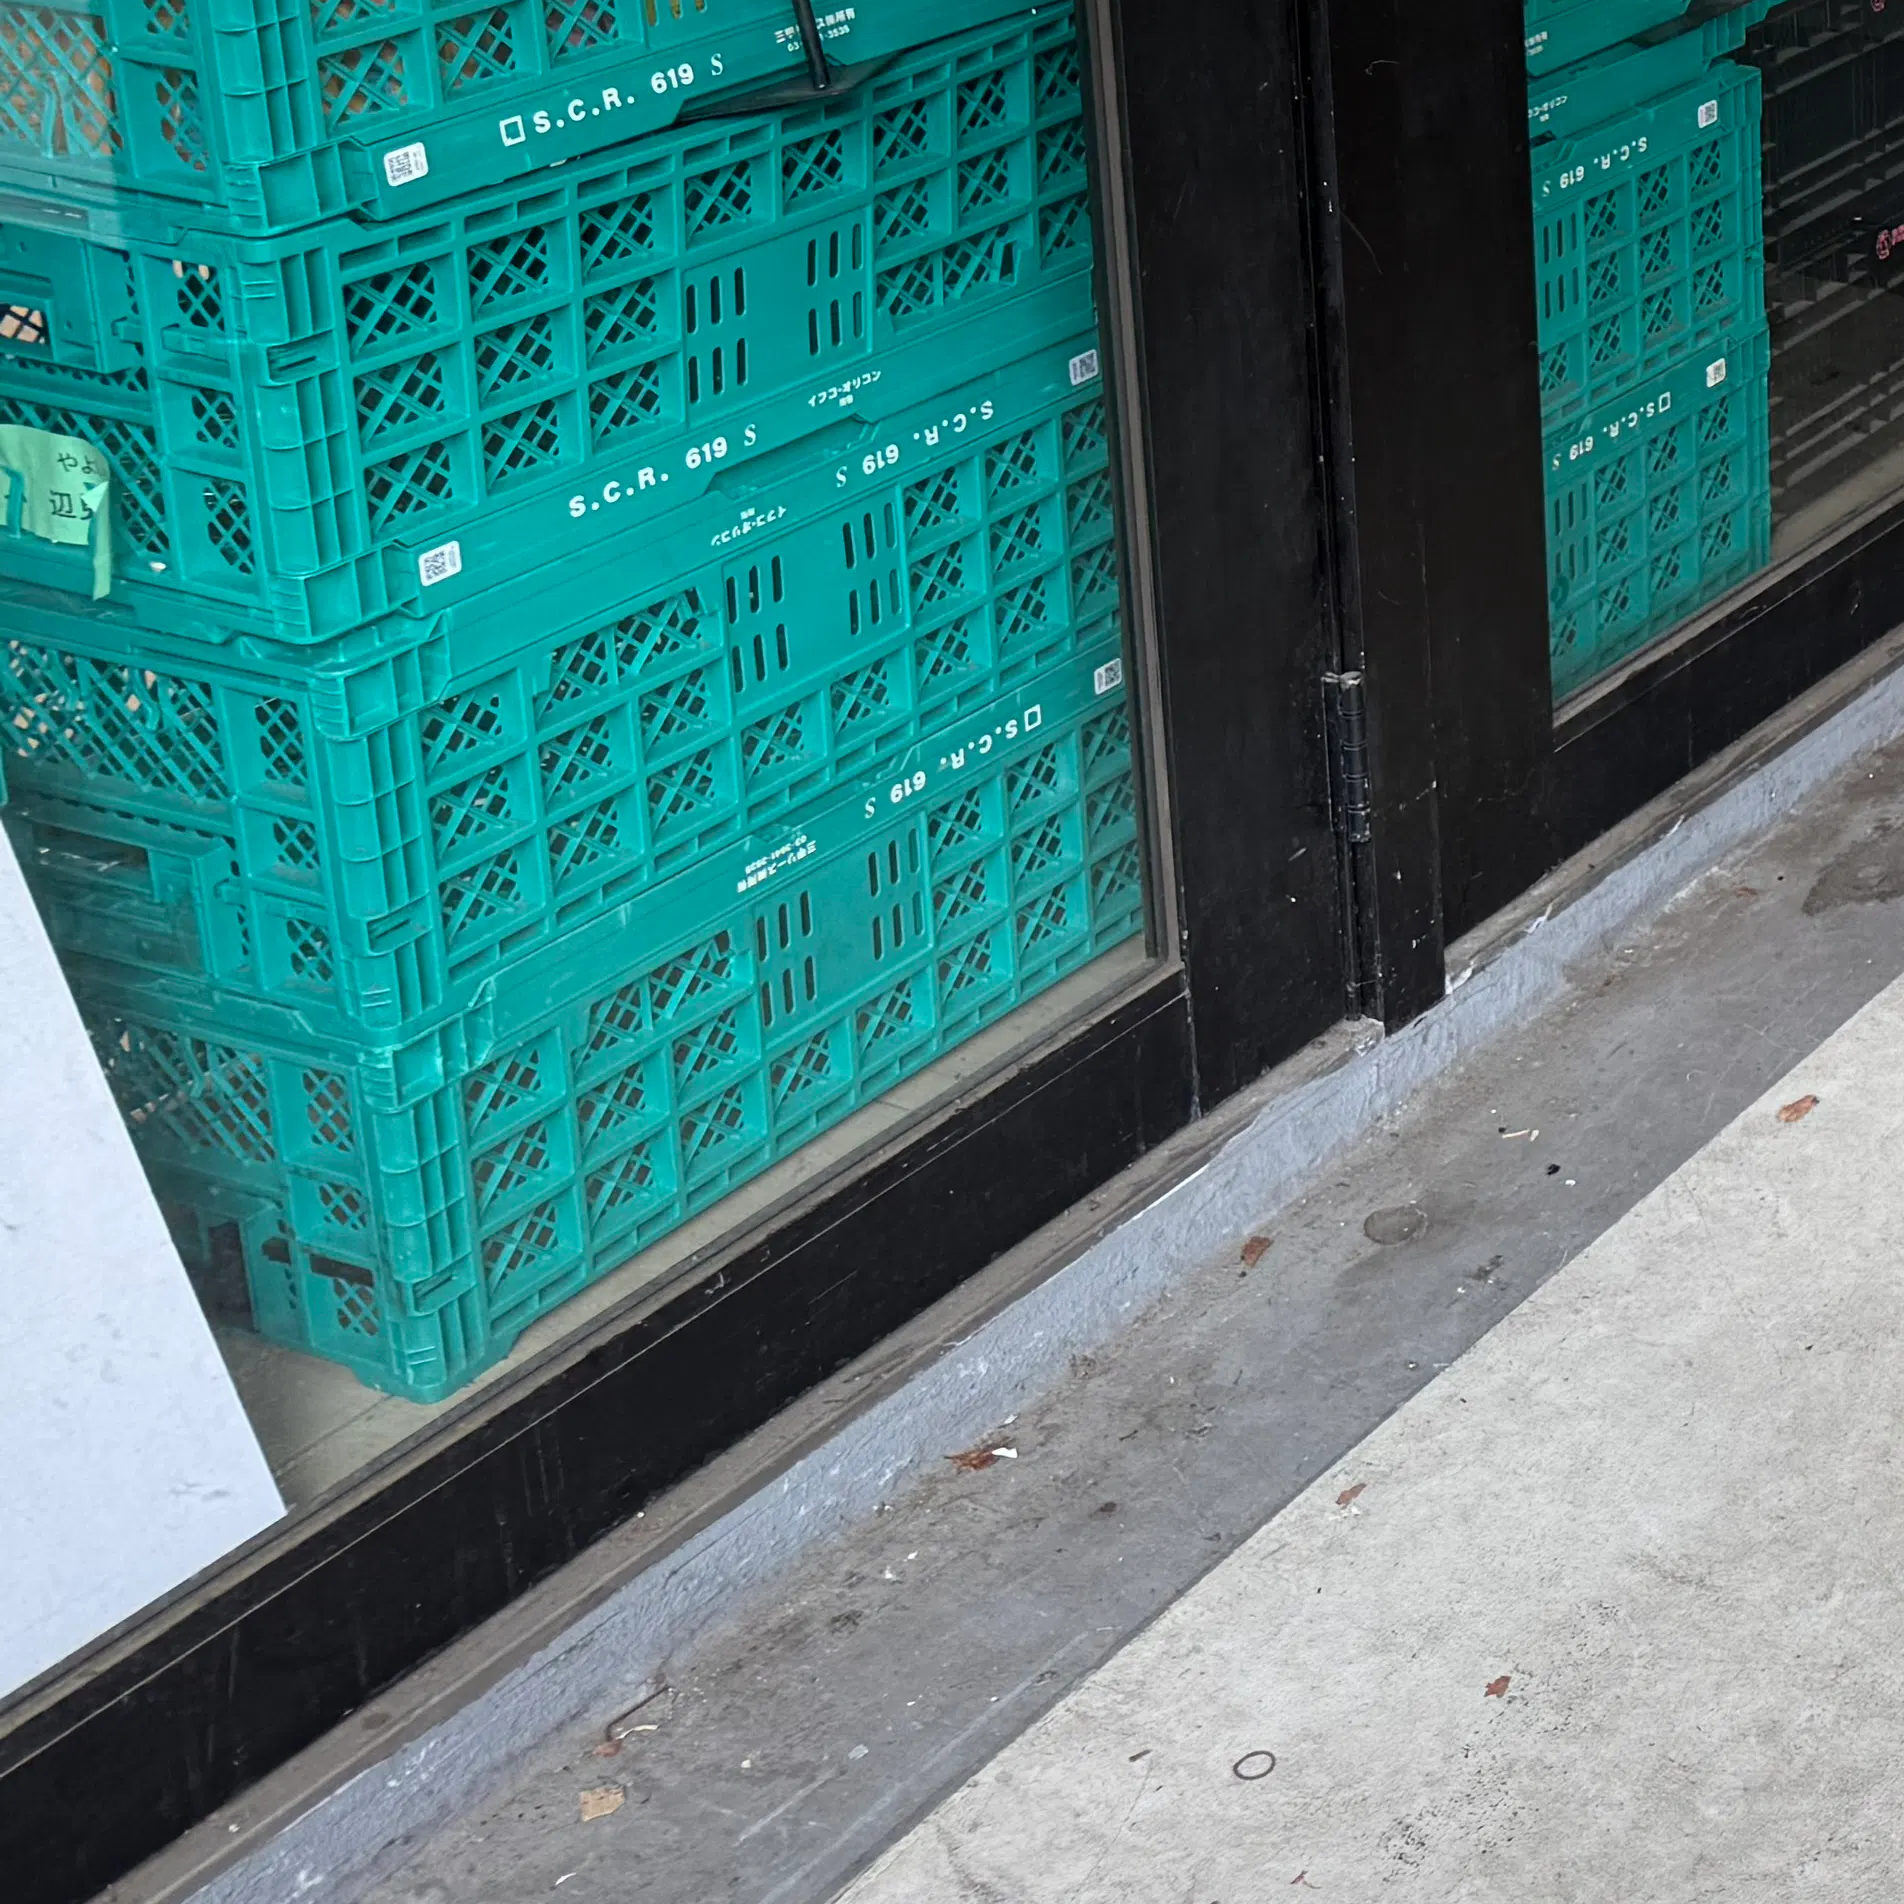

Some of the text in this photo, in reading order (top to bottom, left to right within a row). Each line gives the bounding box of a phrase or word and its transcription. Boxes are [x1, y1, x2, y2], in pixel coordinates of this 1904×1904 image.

[532, 86, 635, 134] S.C.R.
[651, 63, 694, 94] 619
[1559, 166, 1585, 190] 619
[912, 400, 994, 446] S.C.R.
[861, 443, 900, 475] 619
[1568, 436, 1594, 461] 619
[569, 466, 669, 517] S.C.R.
[685, 436, 728, 469] 619
[890, 770, 927, 804] 619
